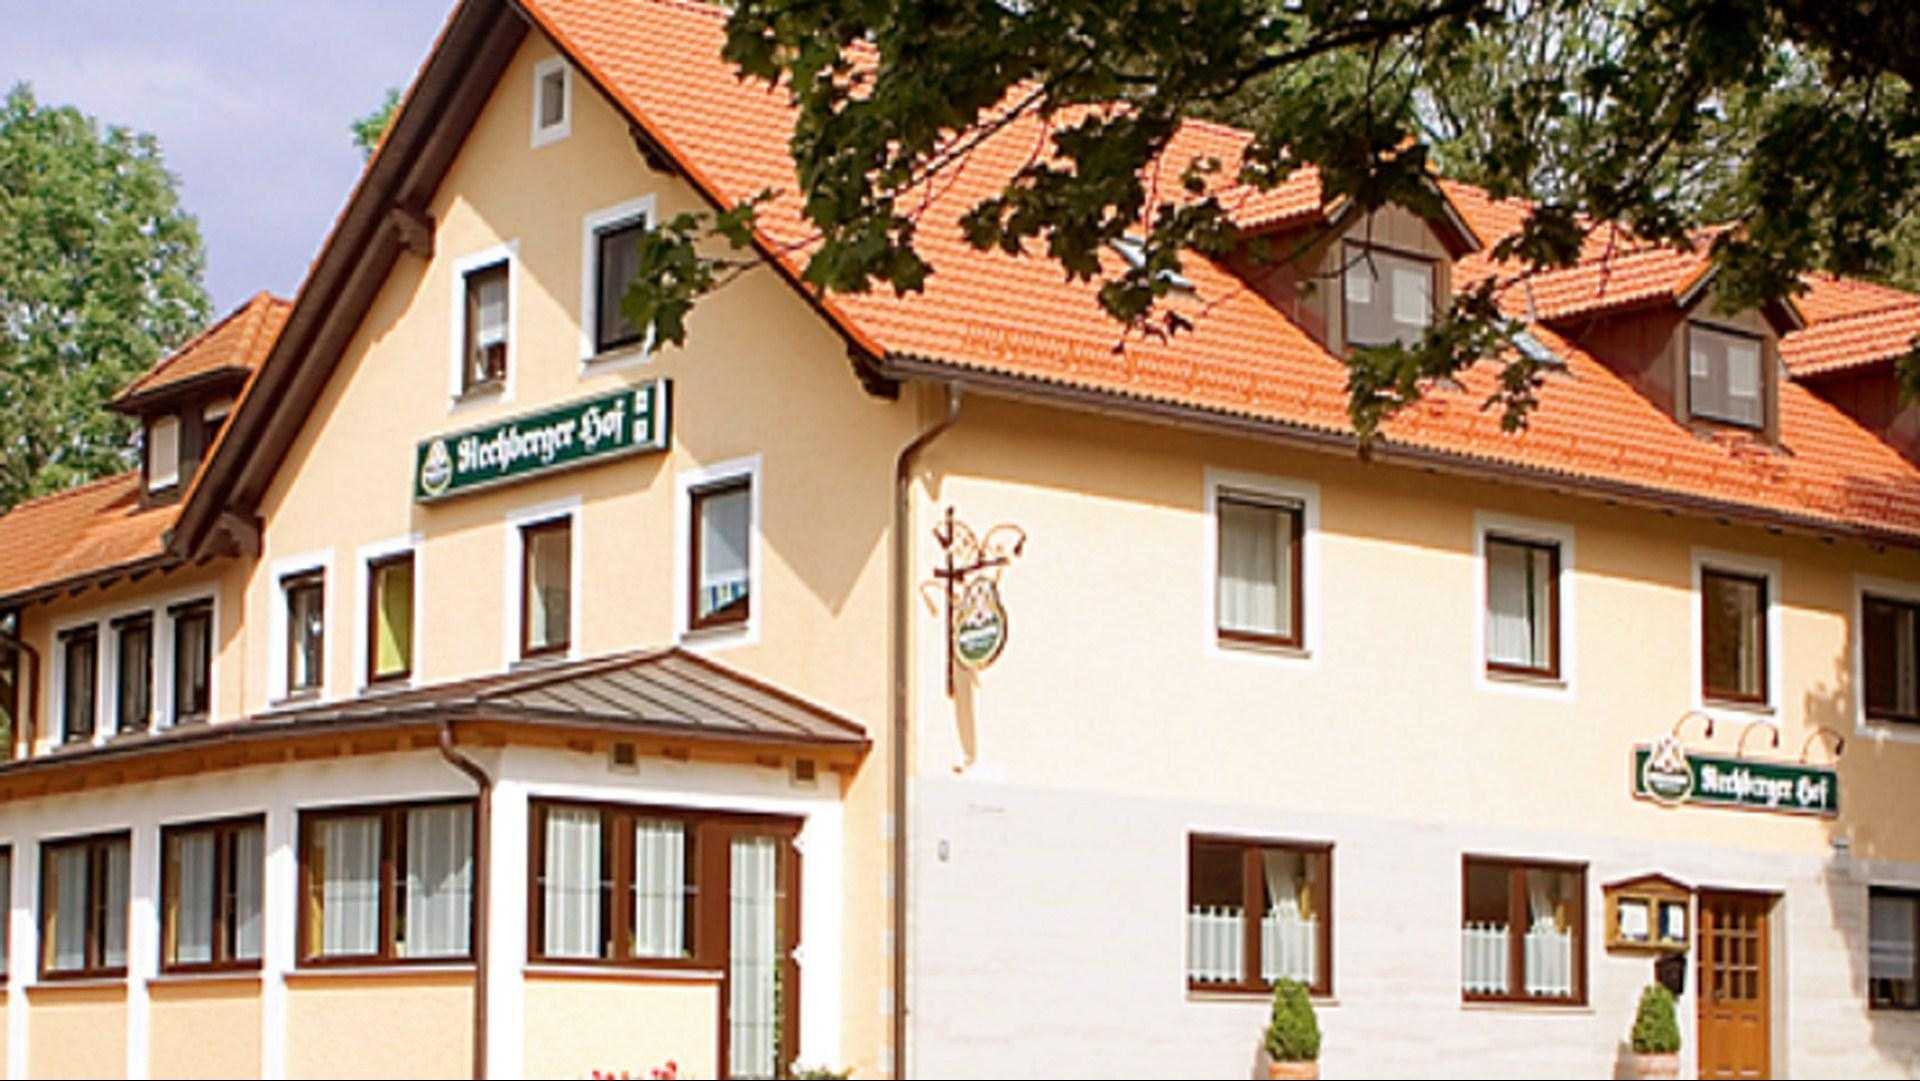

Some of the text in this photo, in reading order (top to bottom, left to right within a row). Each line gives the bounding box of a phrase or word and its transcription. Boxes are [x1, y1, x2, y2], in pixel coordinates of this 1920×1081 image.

[457, 399, 626, 473] Rechberger Hof
[1797, 775, 1828, 808] Hof
